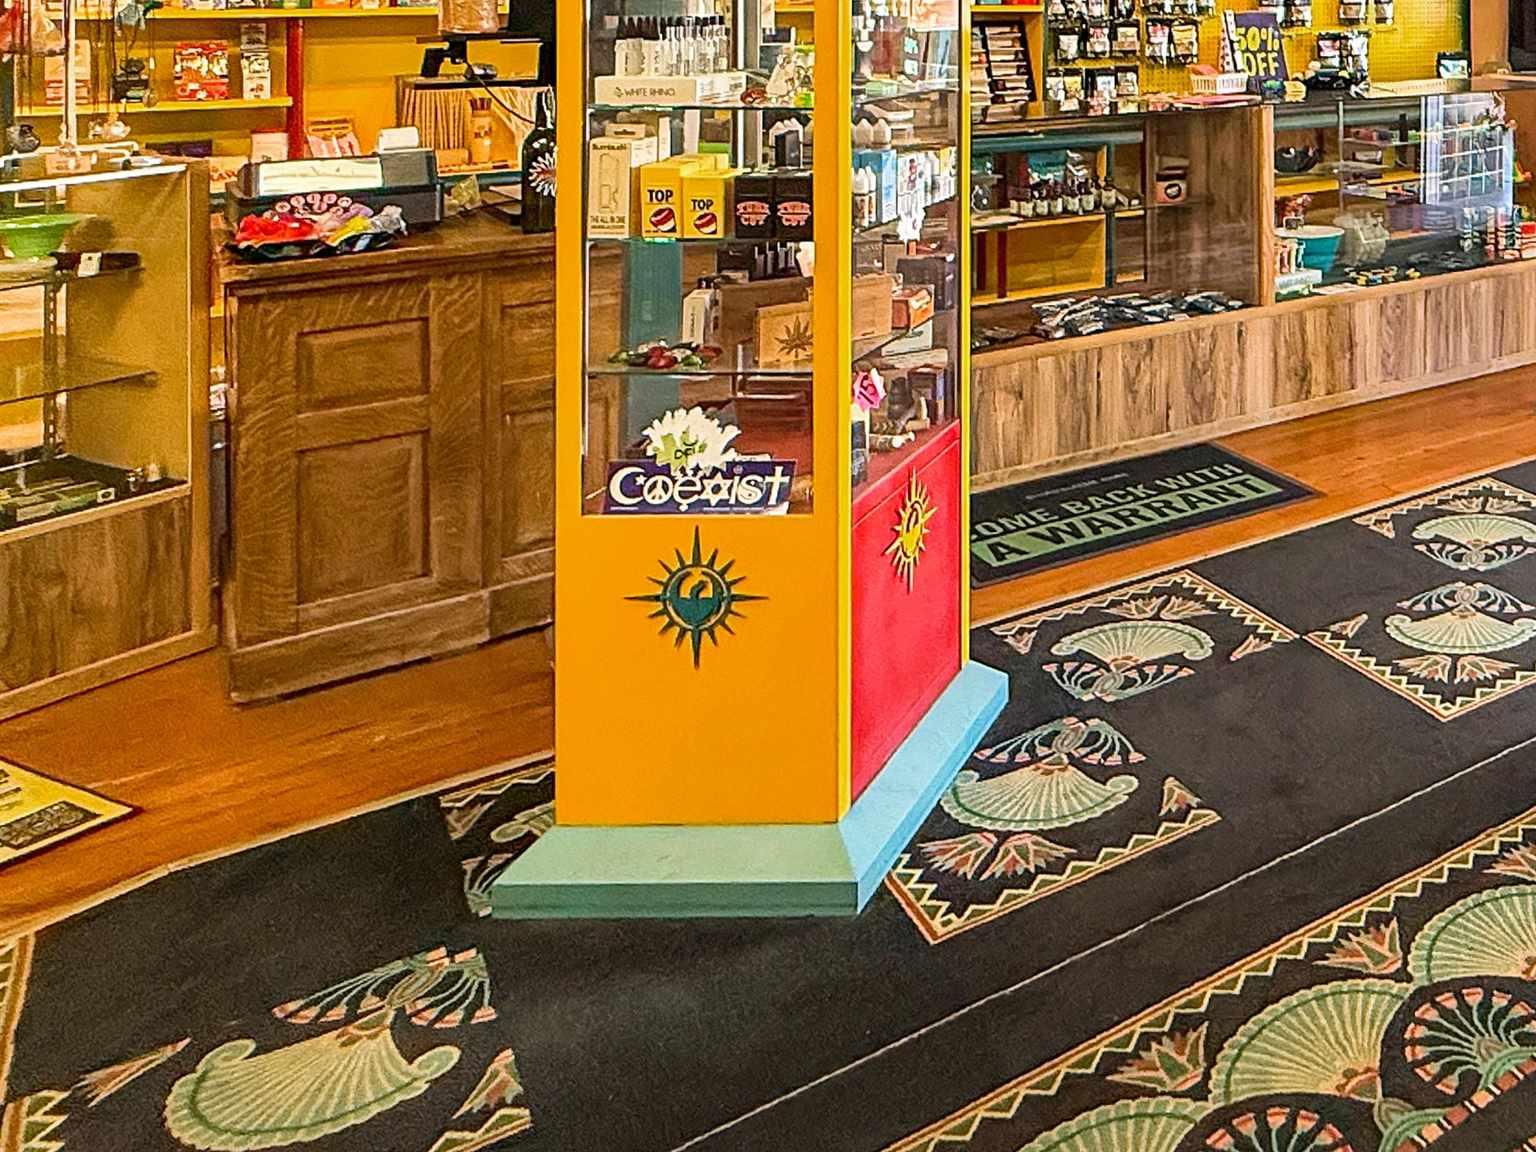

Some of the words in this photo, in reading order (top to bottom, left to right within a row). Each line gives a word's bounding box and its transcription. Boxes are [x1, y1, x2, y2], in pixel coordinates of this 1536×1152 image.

[1243, 51, 1280, 77] OFF
[624, 87, 648, 97] WHITE
[649, 87, 676, 97] RHINO
[647, 189, 674, 203] TOP
[691, 199, 715, 211] TOP
[971, 507, 1059, 540] OME
[1061, 484, 1156, 514] BACK
[1155, 462, 1245, 491] WITH
[985, 540, 1028, 564] A
[1024, 478, 1267, 547] WARRANT
